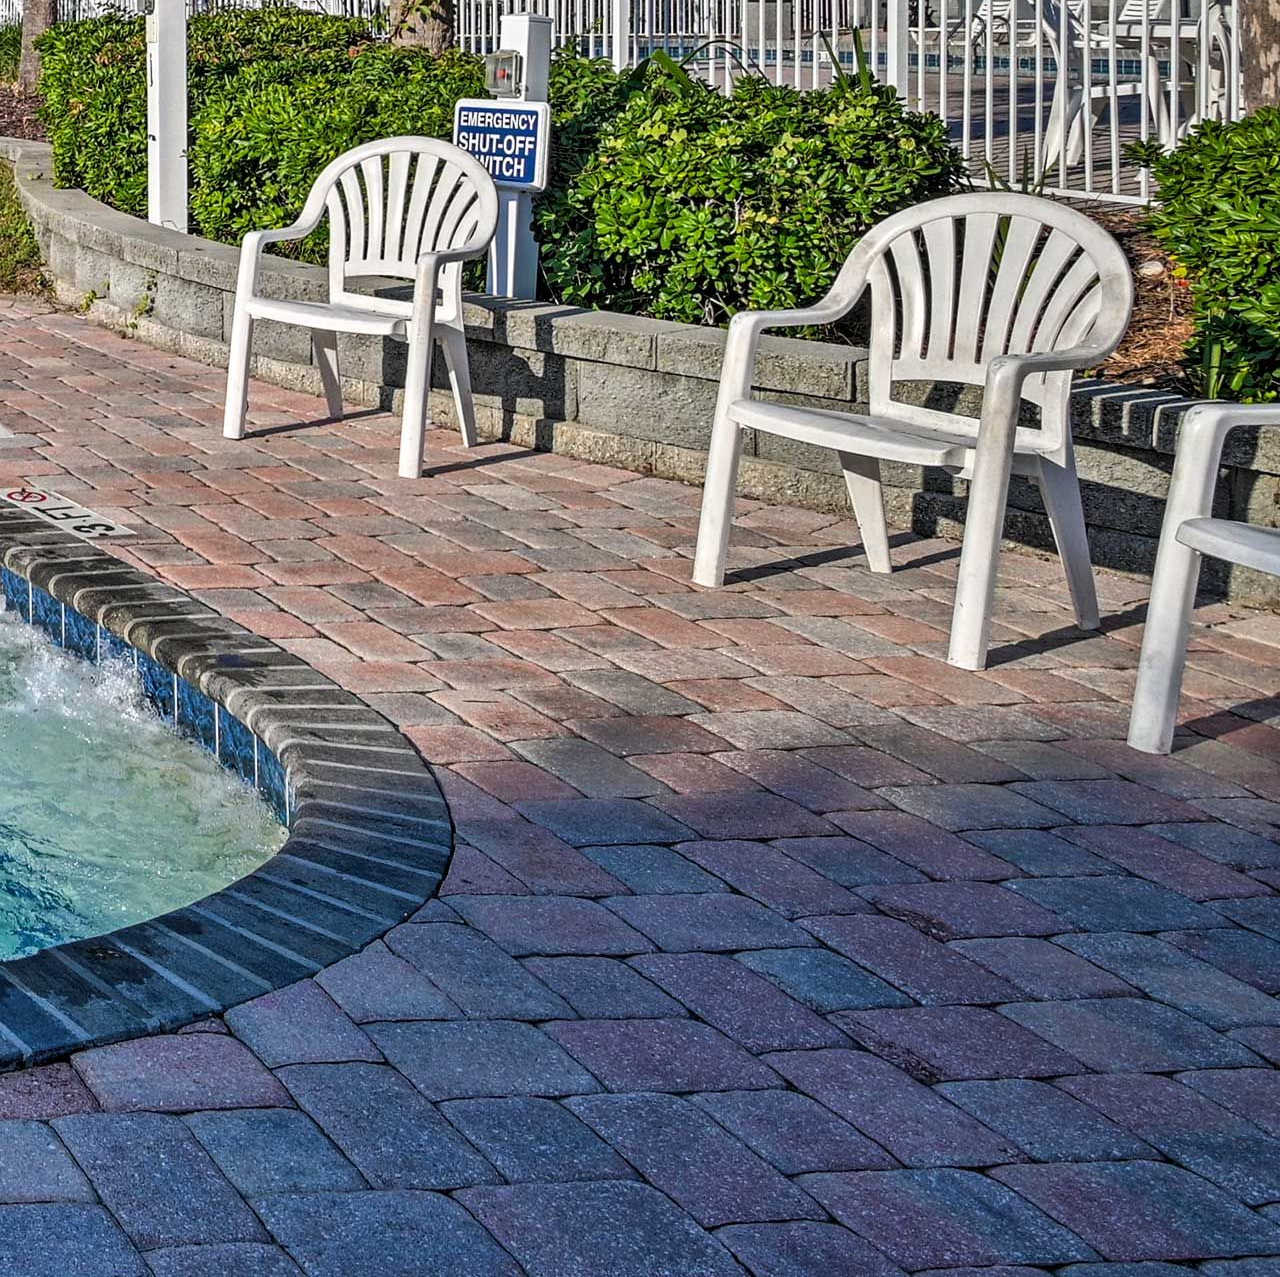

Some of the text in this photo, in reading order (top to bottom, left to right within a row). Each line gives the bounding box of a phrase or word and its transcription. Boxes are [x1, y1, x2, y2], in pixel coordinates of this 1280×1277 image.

[460, 111, 536, 130] EMERGENCY
[459, 132, 535, 156] SHUT-OFF
[34, 506, 92, 521] FT
